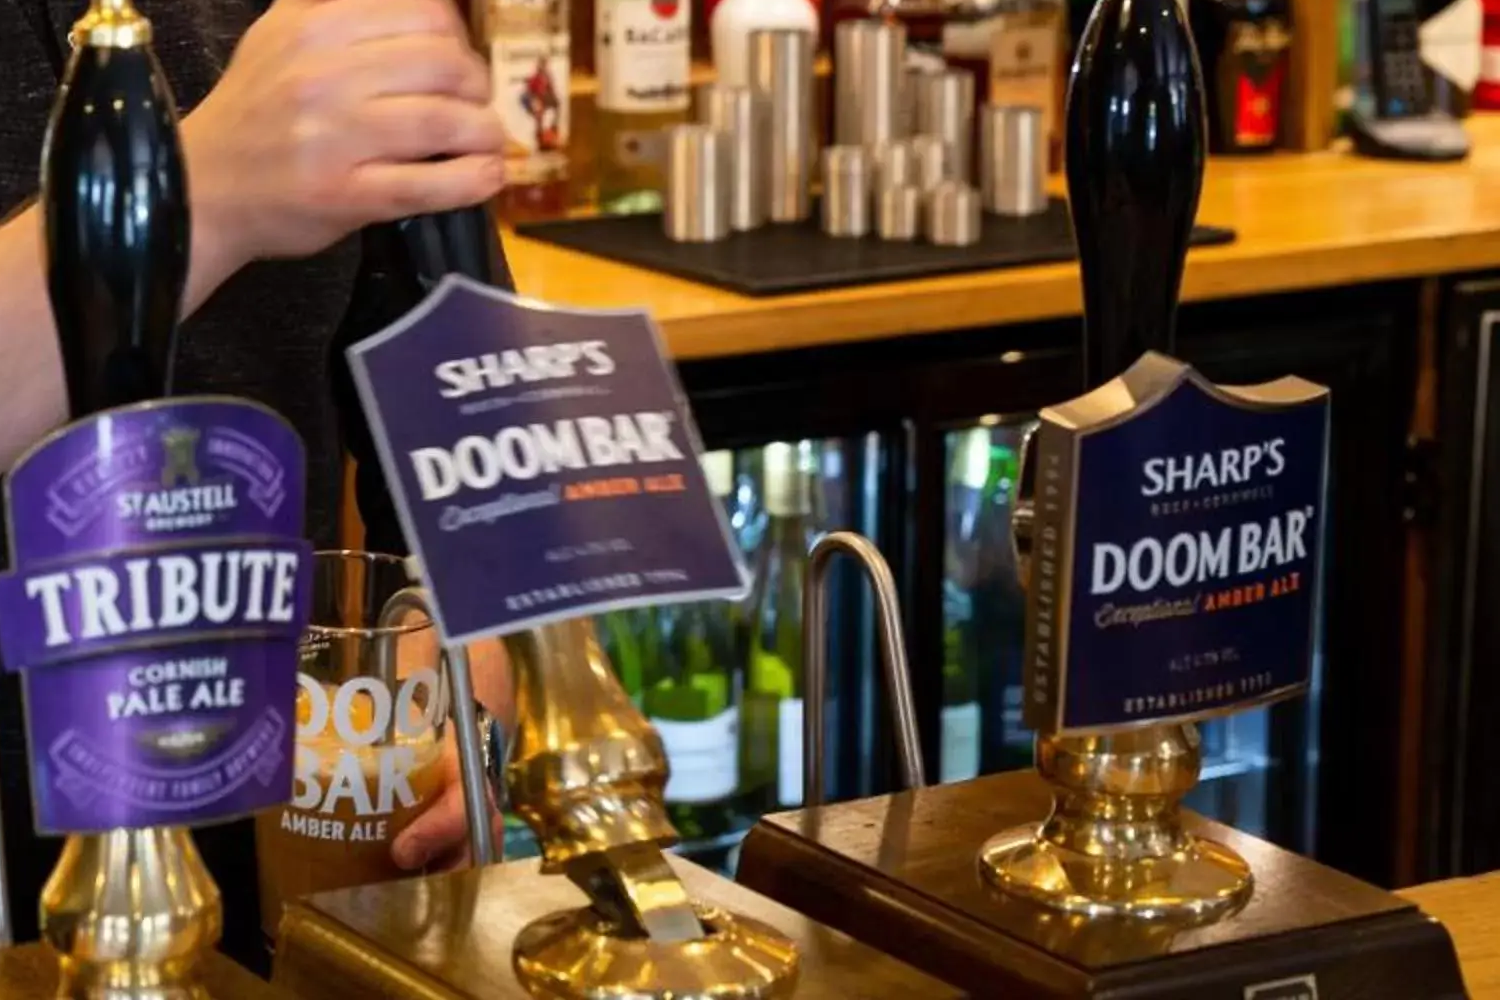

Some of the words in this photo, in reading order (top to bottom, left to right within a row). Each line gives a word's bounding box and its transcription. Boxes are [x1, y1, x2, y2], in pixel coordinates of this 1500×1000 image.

[434, 340, 615, 398] SHARP'S
[409, 419, 584, 501] DOOM
[578, 411, 684, 467] BAR
[1141, 438, 1286, 497] SHARP'S
[144, 484, 238, 514] AUSTELL
[1091, 527, 1232, 596] DOOM
[1238, 507, 1309, 574] BAR
[25, 550, 299, 647] TRIBUTE
[1203, 582, 1265, 612] AMBER
[1270, 572, 1301, 598] ALE
[128, 657, 228, 689] CORNISH
[1123, 681, 1235, 714] ESTABLISHED
[107, 683, 183, 721] PALE
[190, 678, 245, 709] ALE
[296, 667, 450, 746] DOO
[281, 810, 345, 841] AMBER
[350, 820, 387, 842] ALE
